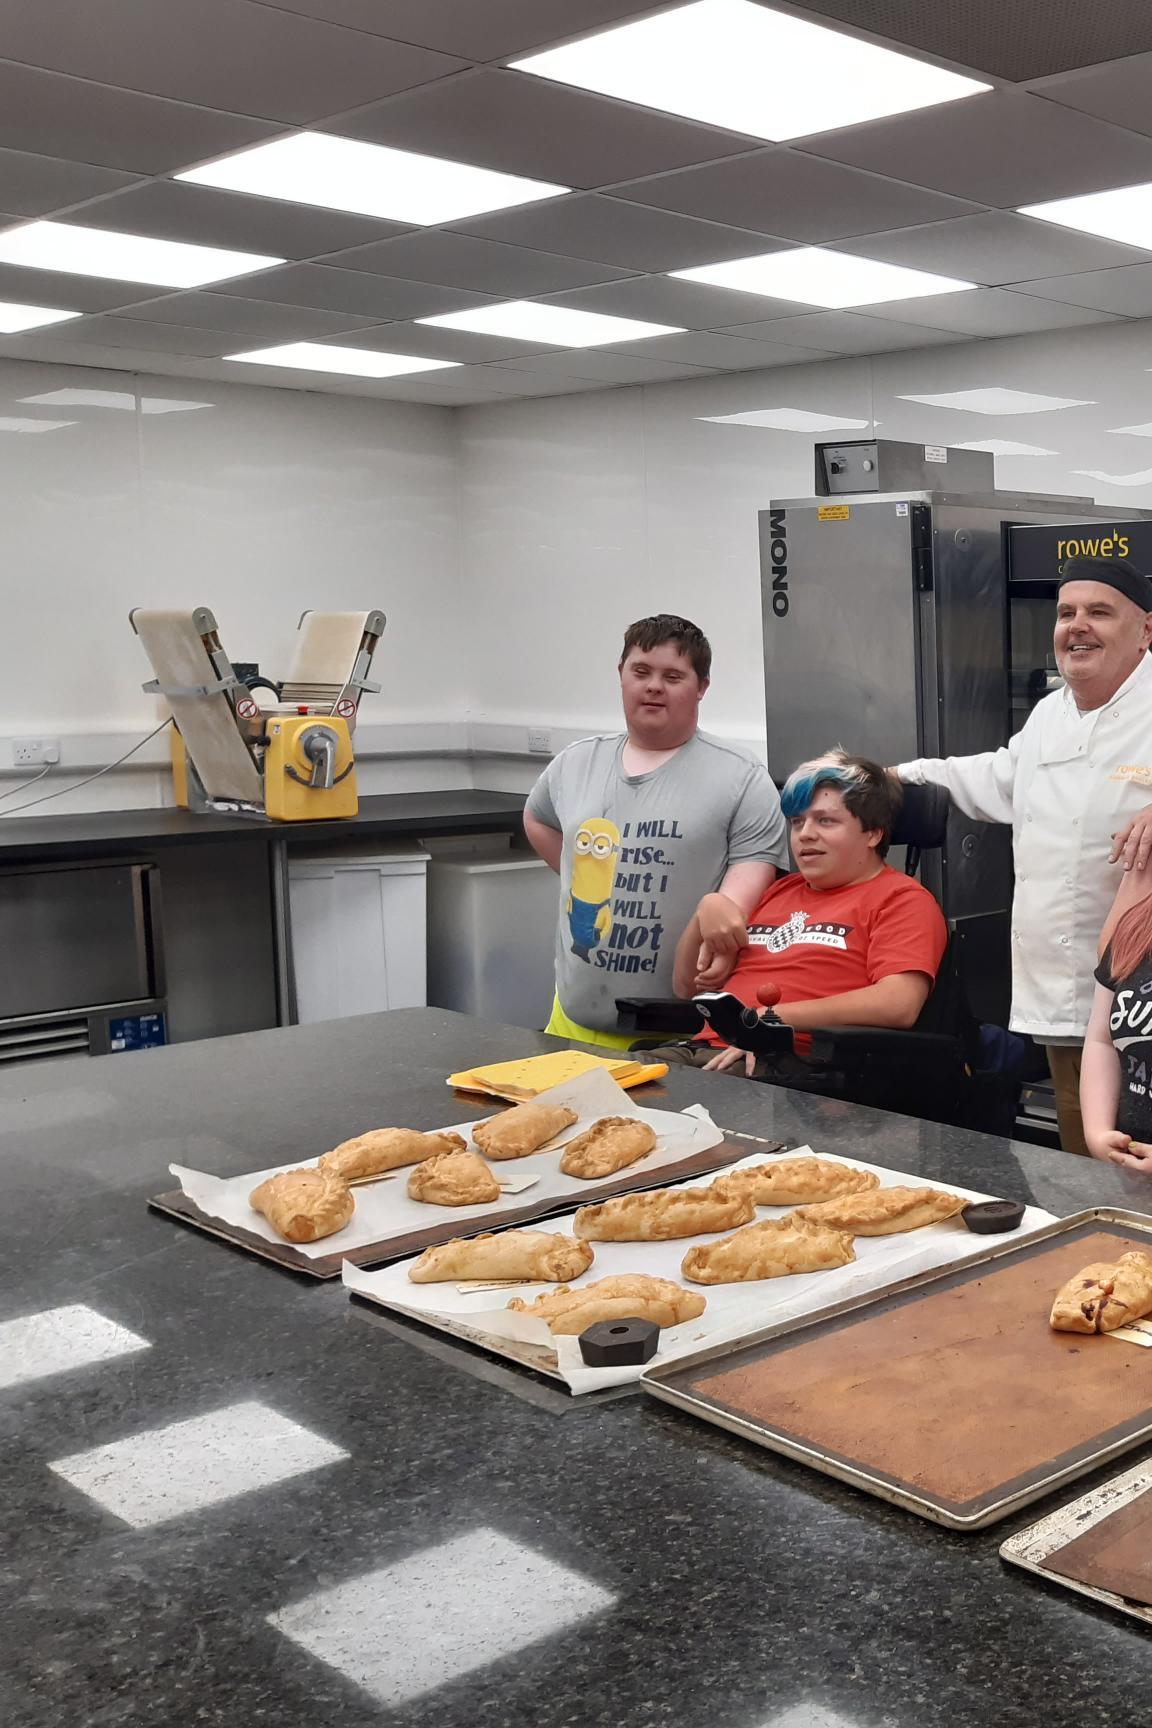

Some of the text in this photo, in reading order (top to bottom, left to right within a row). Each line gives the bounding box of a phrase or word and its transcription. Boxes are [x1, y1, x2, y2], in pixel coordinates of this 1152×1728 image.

[1057, 528, 1129, 559] rowe's
[770, 509, 789, 618] MONO
[623, 820, 683, 839] I WILL
[615, 873, 668, 893] but I
[613, 899, 662, 919] WILL
[608, 923, 664, 950] not
[1129, 1082, 1146, 1095] HARD
